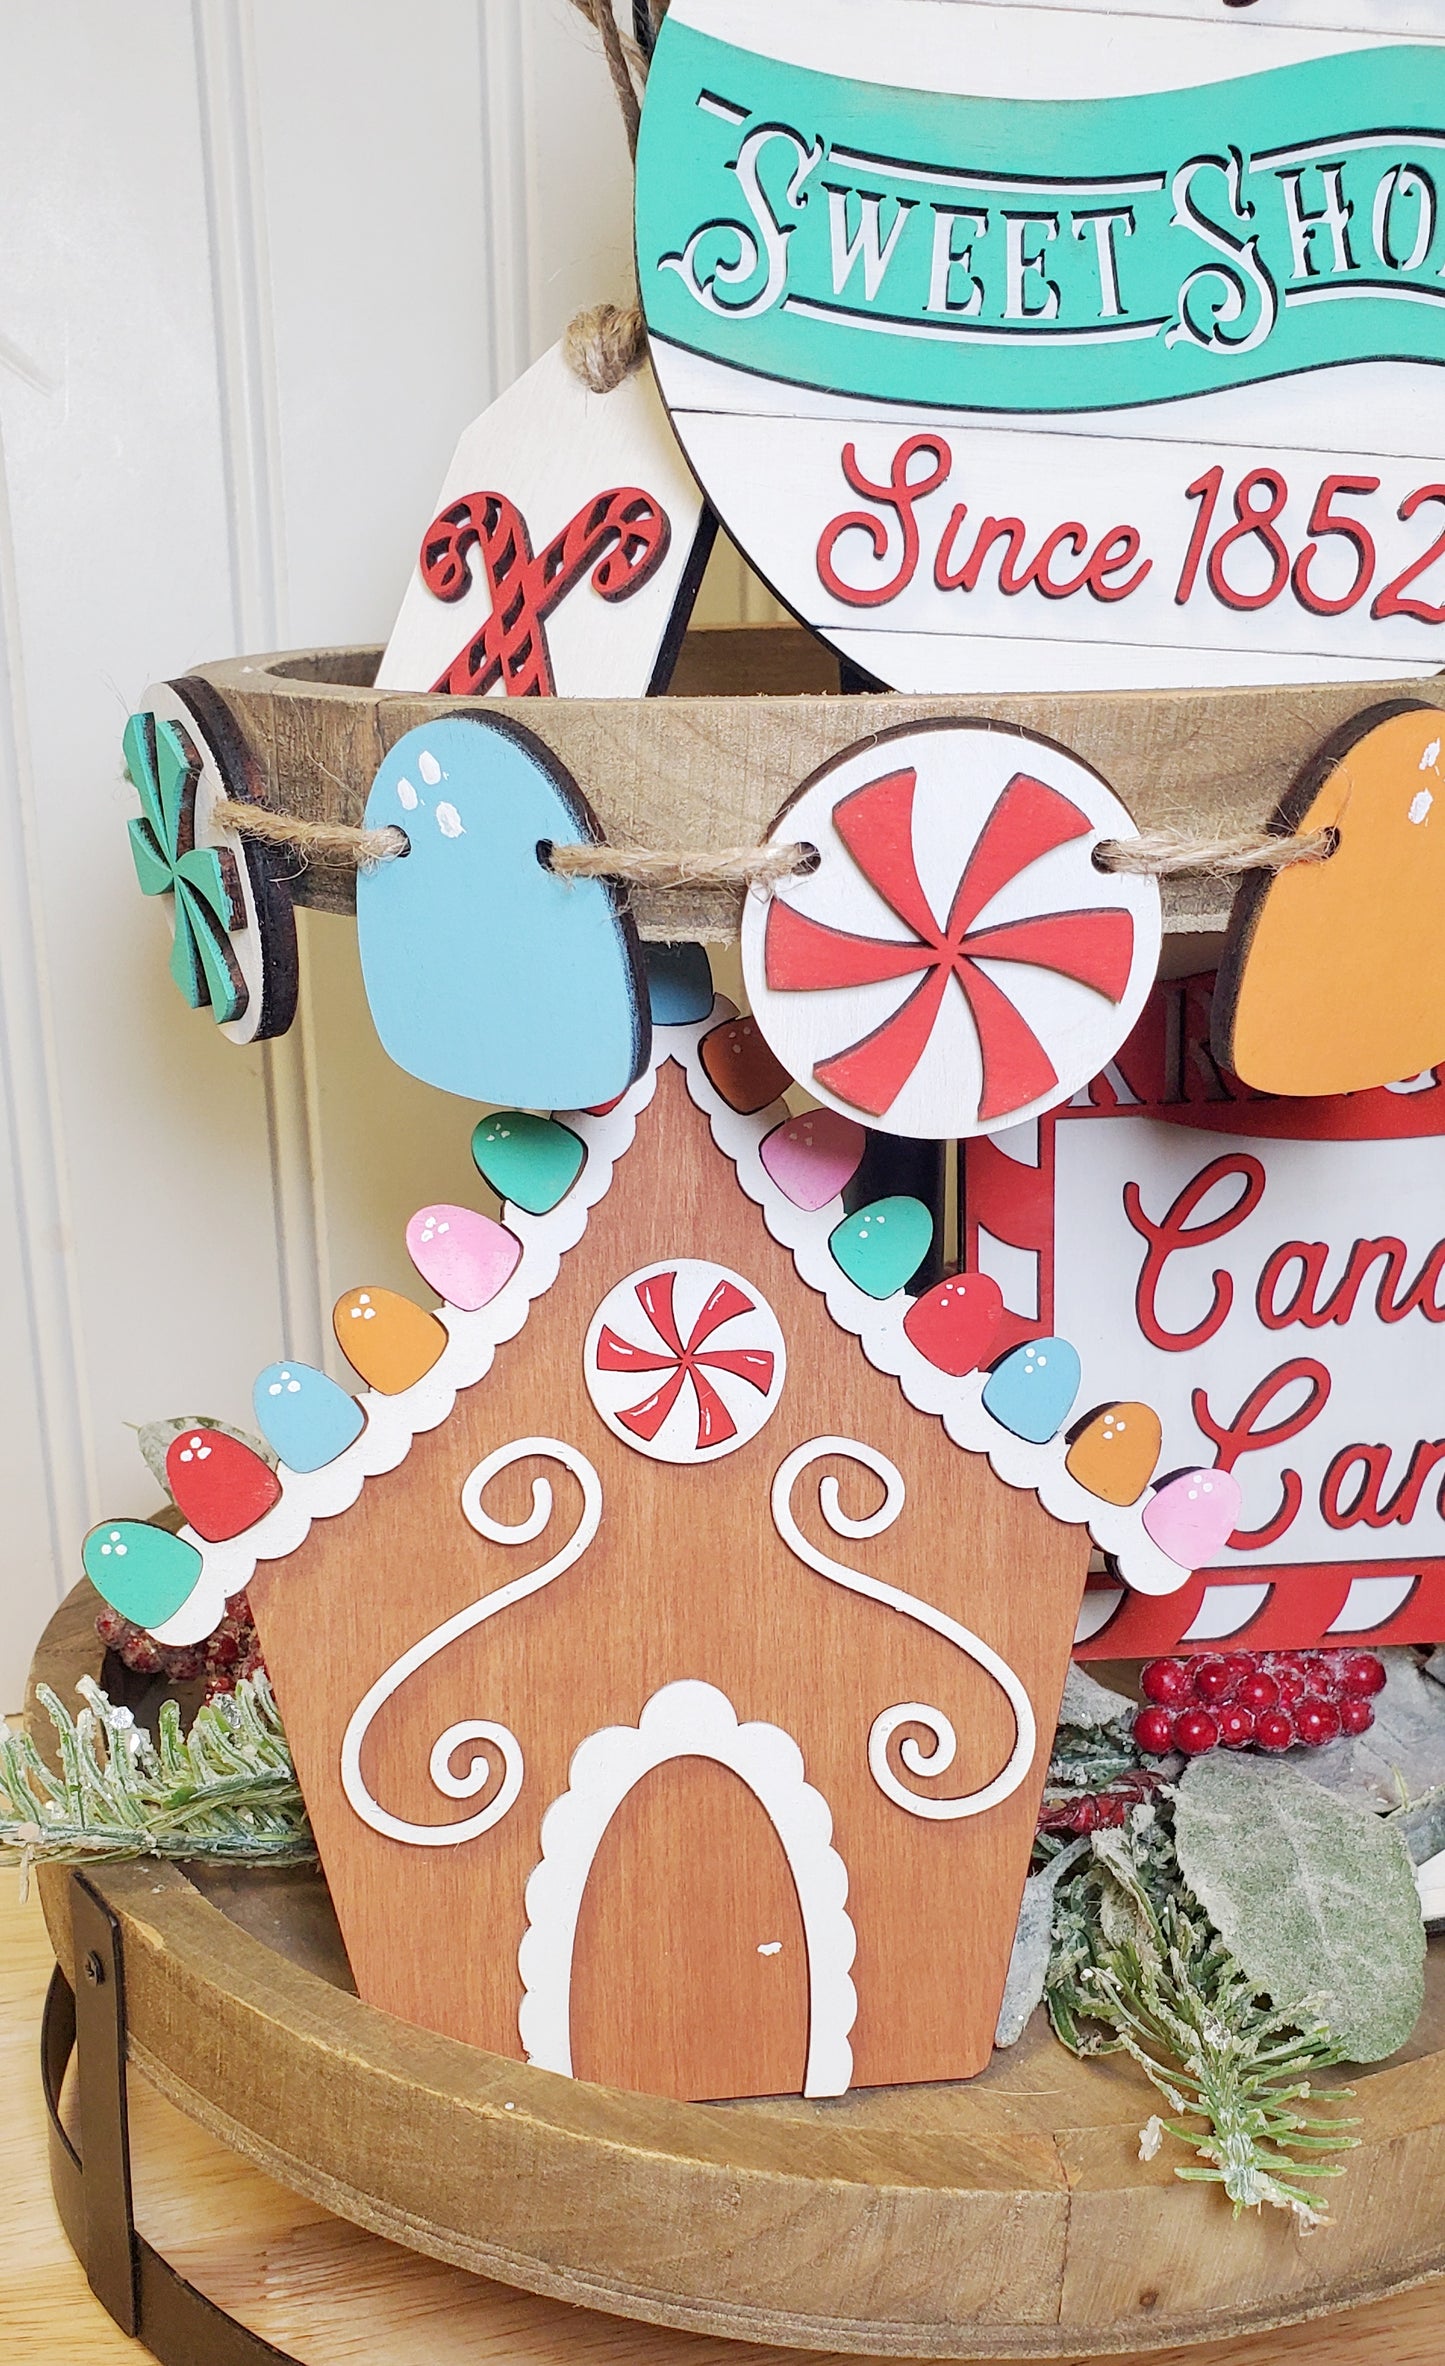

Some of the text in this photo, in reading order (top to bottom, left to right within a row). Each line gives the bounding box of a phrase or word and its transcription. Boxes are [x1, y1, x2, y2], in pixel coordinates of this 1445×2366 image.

[658, 121, 1445, 355] SWEET SHO
[816, 433, 1445, 625] Since 1852
